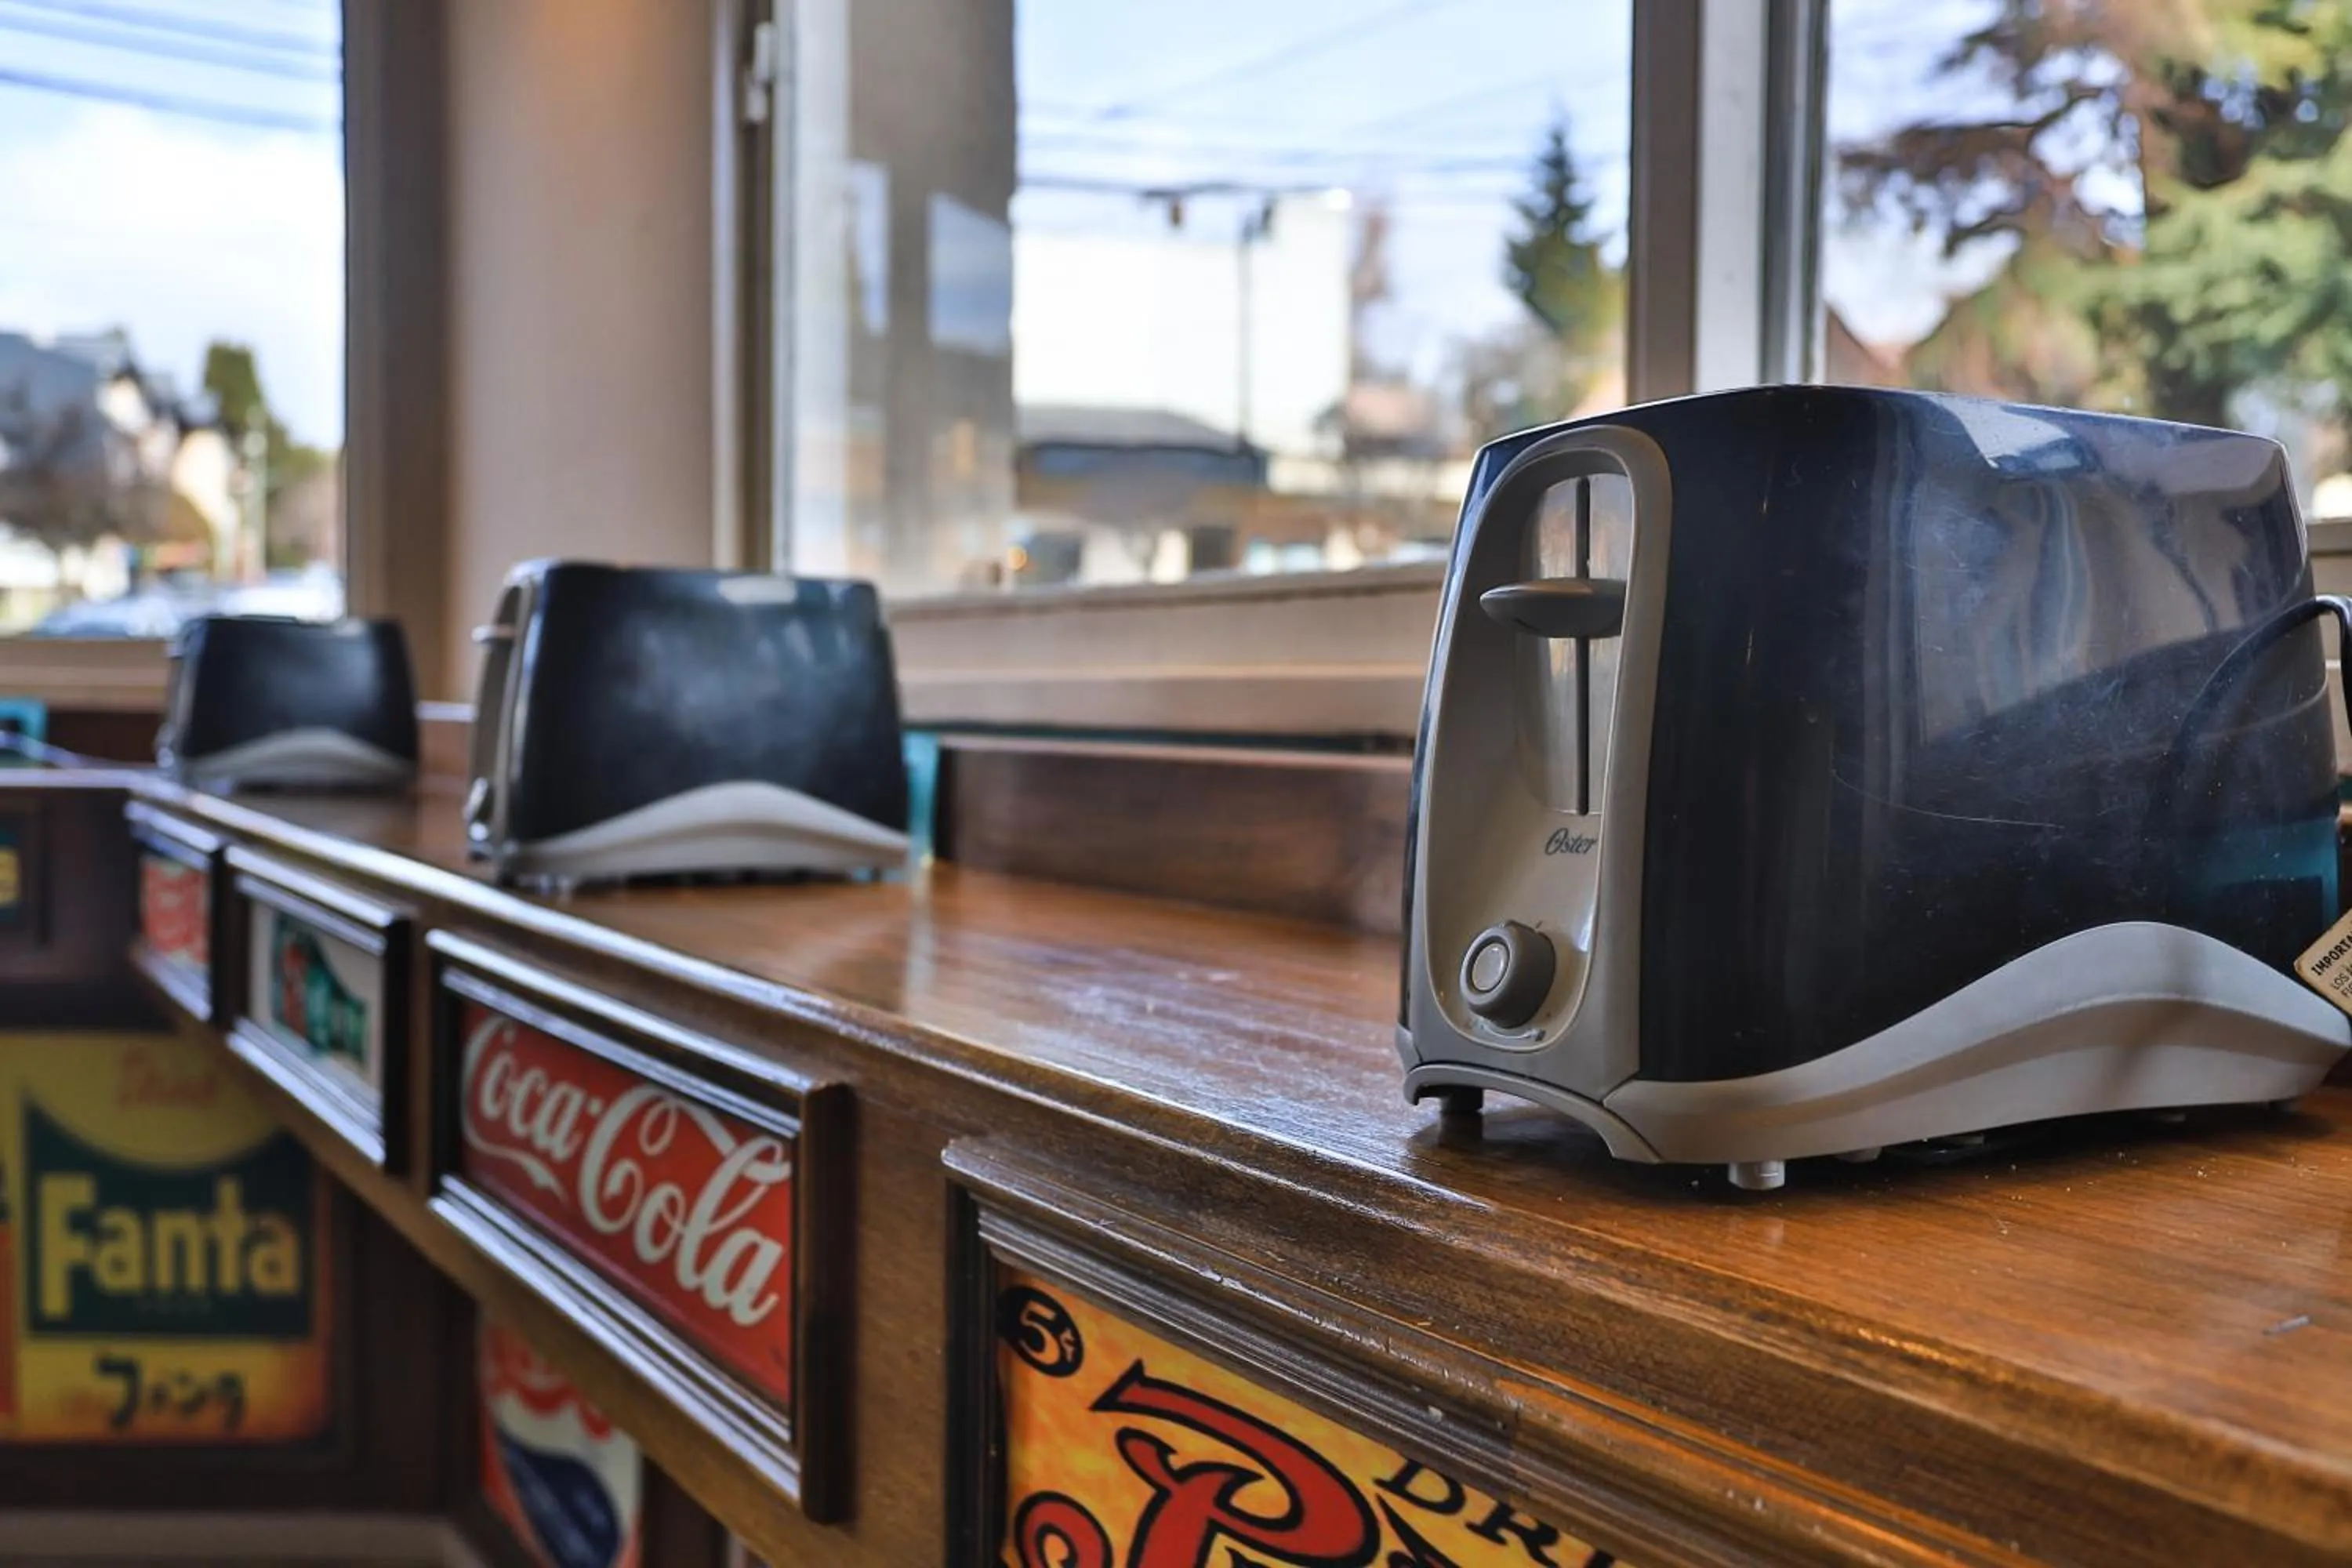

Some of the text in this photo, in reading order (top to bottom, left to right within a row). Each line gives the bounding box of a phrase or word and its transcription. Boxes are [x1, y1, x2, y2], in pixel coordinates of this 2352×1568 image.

[1544, 828, 1597, 855] Oster
[2310, 931, 2352, 976] IMPORTA
[39, 1172, 300, 1320] Fanta
